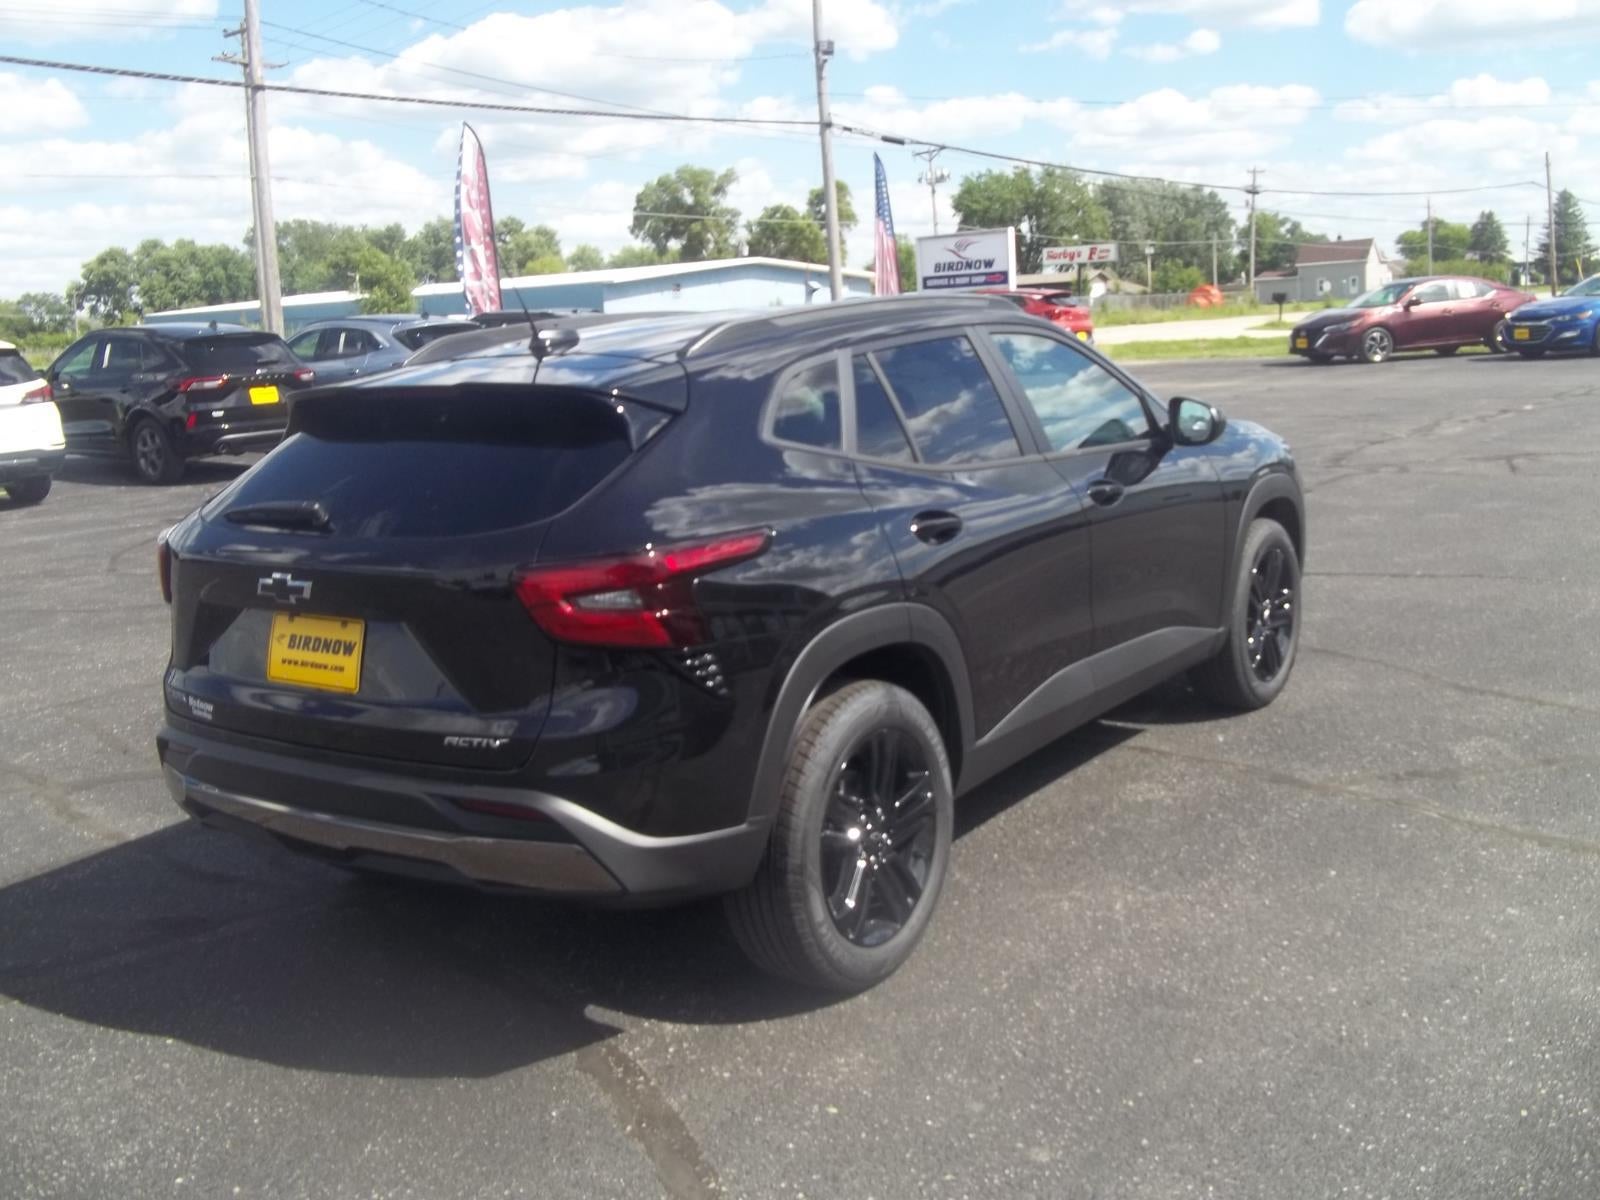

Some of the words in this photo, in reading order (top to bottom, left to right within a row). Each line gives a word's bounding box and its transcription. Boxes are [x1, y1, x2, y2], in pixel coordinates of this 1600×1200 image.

[934, 259, 995, 273] BIRDNOW
[288, 633, 357, 656] BIRDNOW
[281, 657, 344, 672] www.birdnow.com
[444, 736, 510, 748] ACTIV
